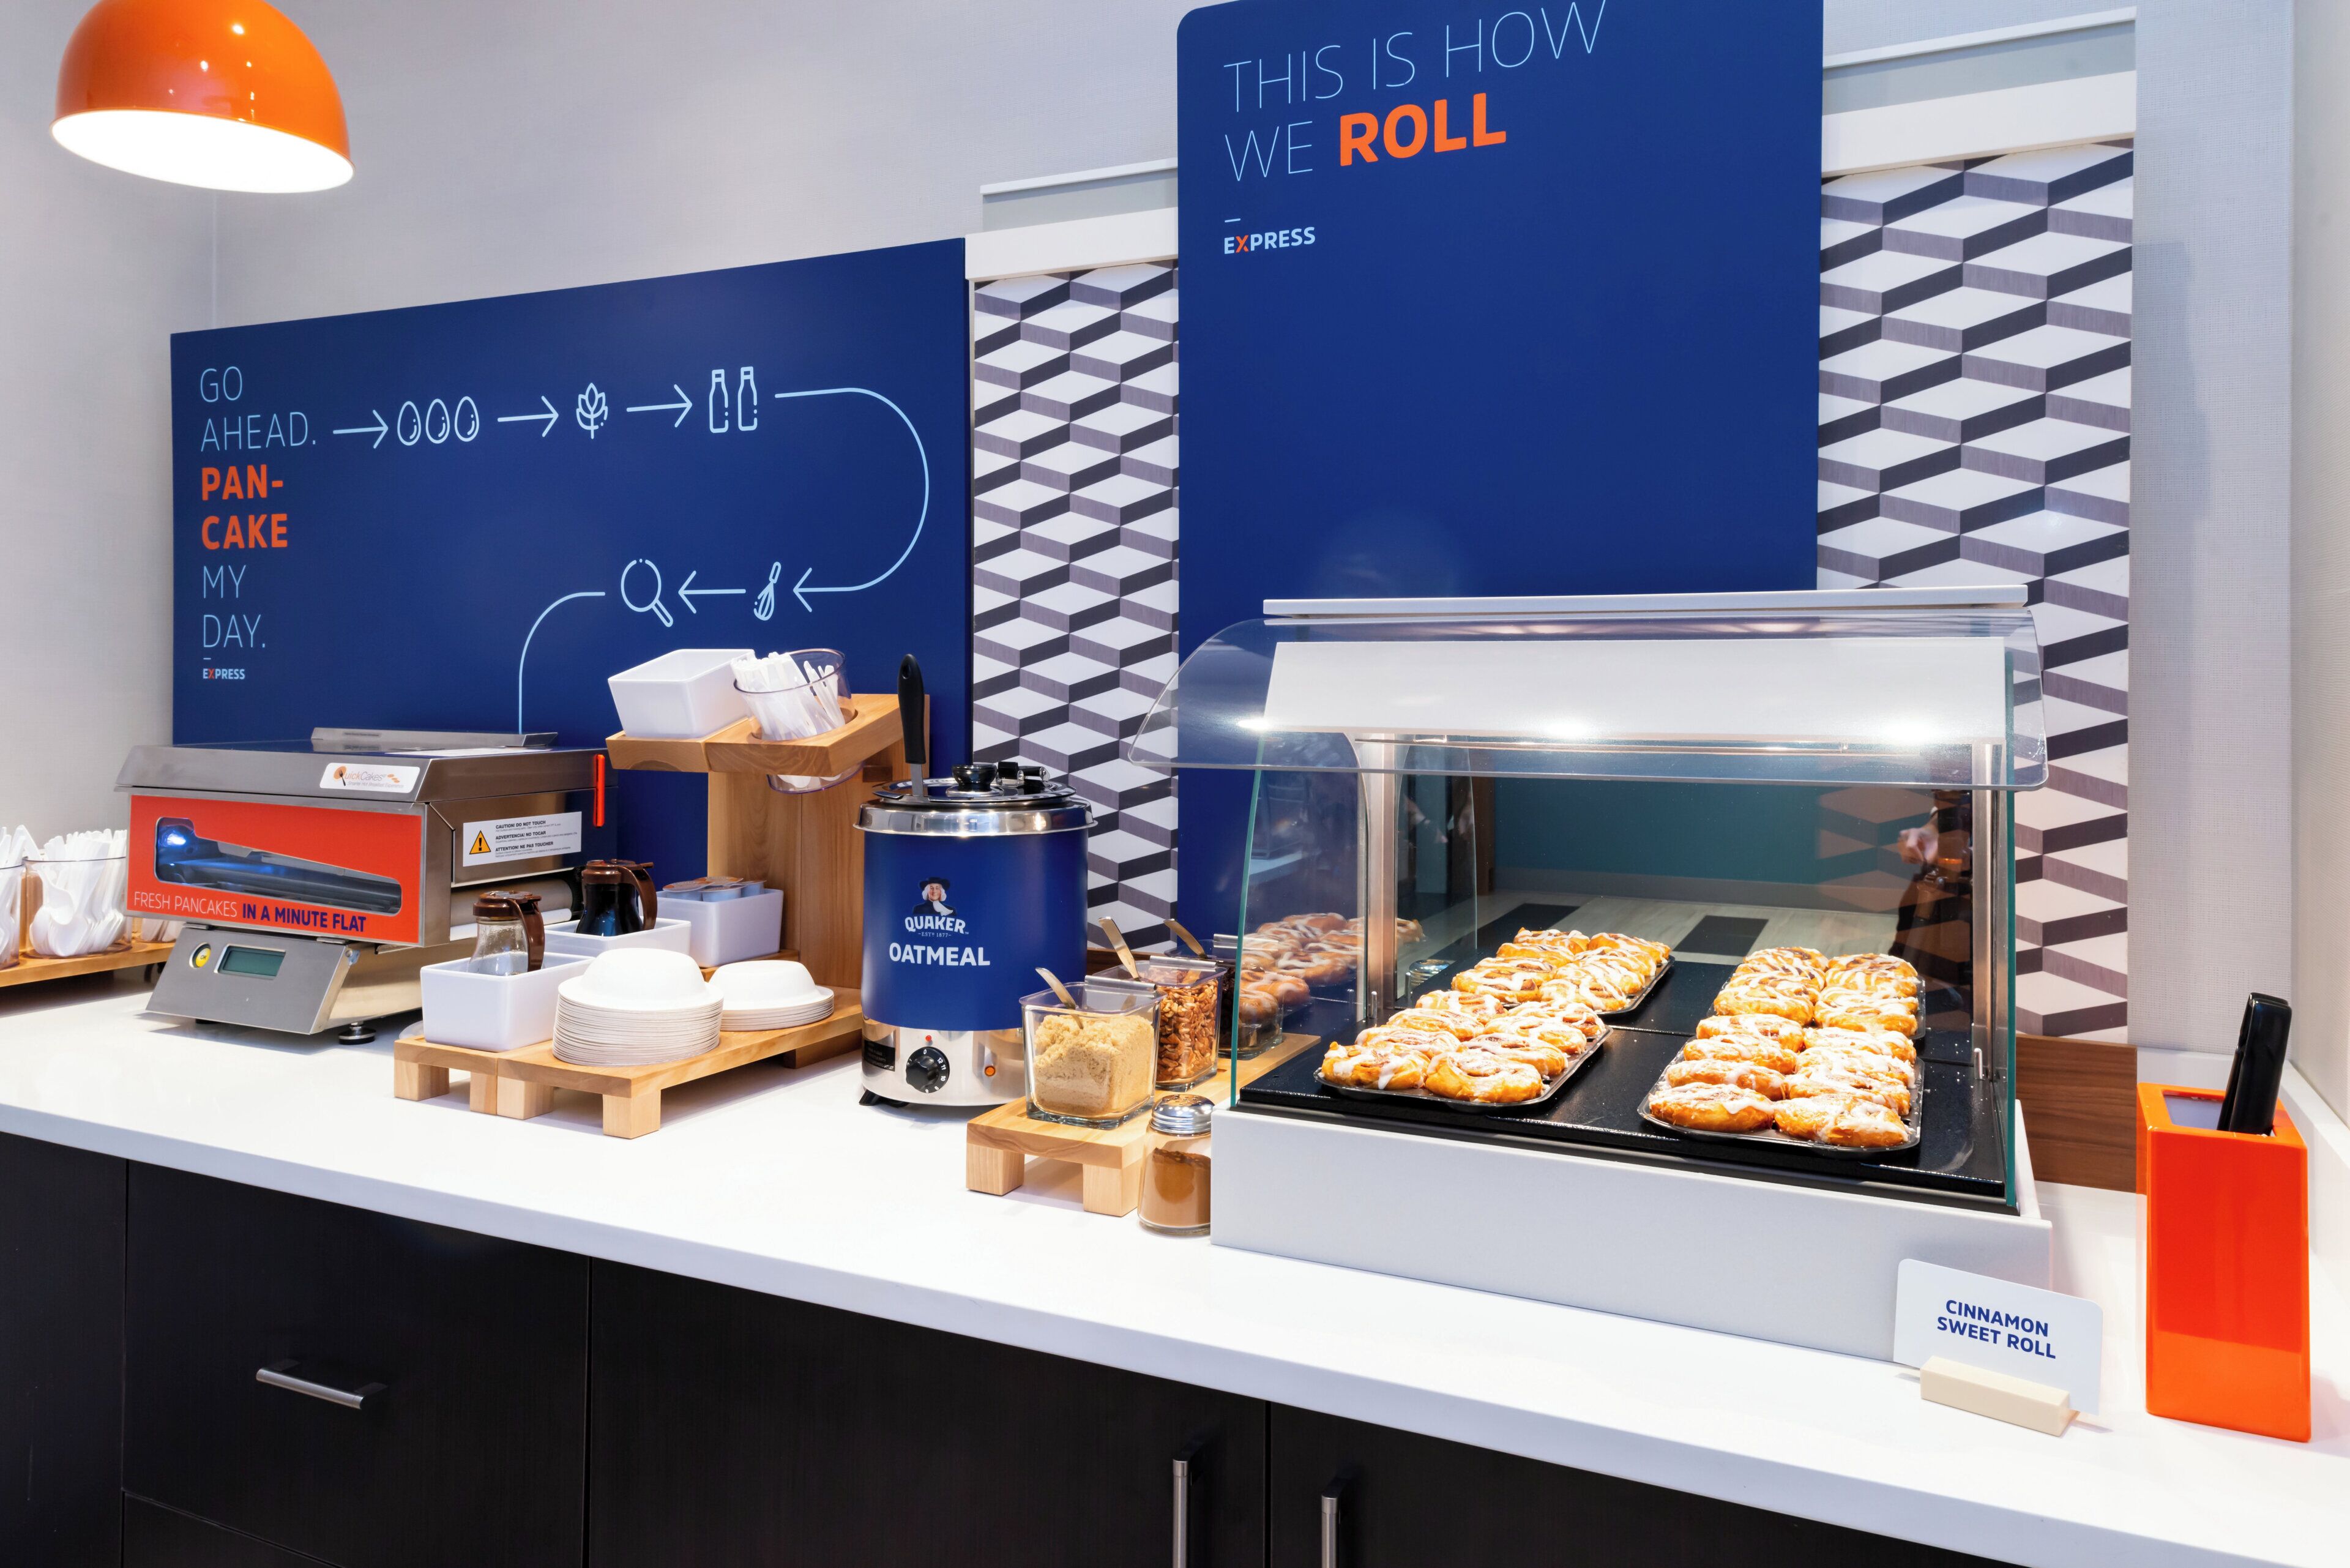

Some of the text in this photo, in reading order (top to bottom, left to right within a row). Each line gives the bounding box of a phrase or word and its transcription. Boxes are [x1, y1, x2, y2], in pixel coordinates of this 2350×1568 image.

[1224, 0, 1606, 112] THIS IS HOW
[1225, 92, 1507, 182] WE ROLL
[1224, 226, 1316, 255] EXPRESS
[200, 366, 242, 403] GO
[201, 411, 316, 452] AHEAD.
[201, 464, 283, 501] PAN-
[201, 513, 288, 550] CAKE
[203, 564, 246, 599] MY
[203, 614, 266, 648] DAY.
[202, 668, 245, 680] EXPRESS
[133, 891, 367, 932] FRESH PANCAKES IN A MINUTE FLAT
[905, 916, 966, 934] QUAKER
[889, 942, 991, 966] OATMEAL
[1945, 1299, 2048, 1337] CINNAMON
[1937, 1316, 2056, 1359] SWEET ROLL
